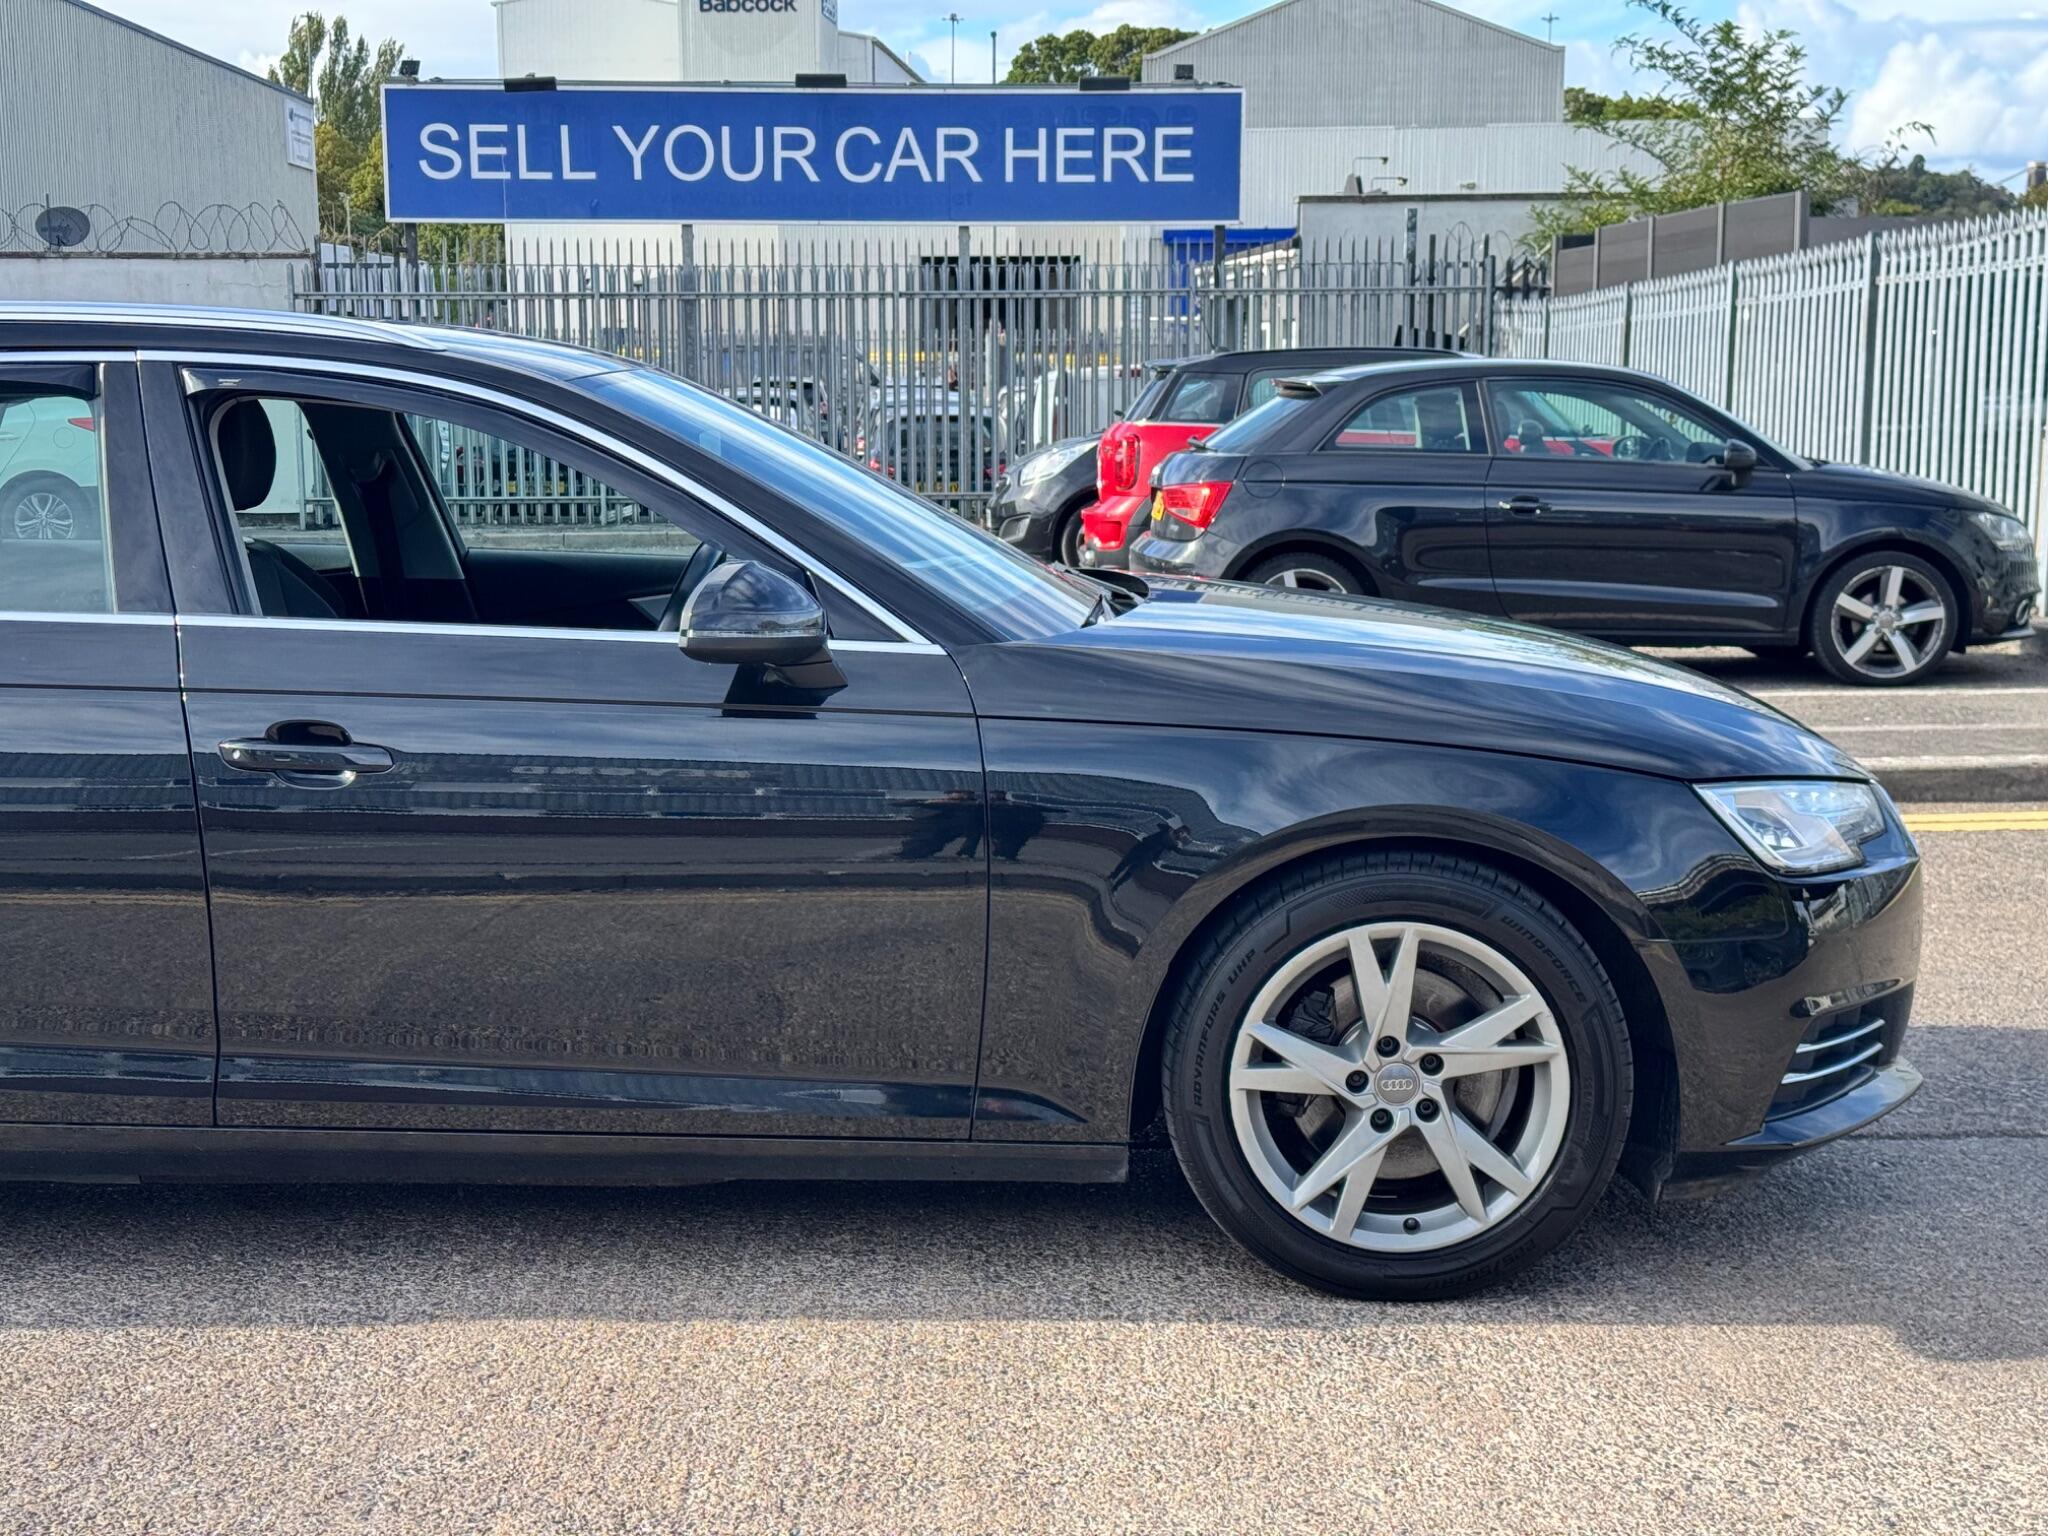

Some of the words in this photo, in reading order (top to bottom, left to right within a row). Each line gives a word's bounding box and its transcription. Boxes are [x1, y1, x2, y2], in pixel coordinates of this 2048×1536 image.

[699, 0, 797, 13] Babcock
[418, 122, 597, 181] SELL
[612, 124, 821, 182] YOUR
[834, 126, 983, 183] CAR
[1004, 126, 1195, 183] HERE
[1227, 948, 1256, 985] UHP
